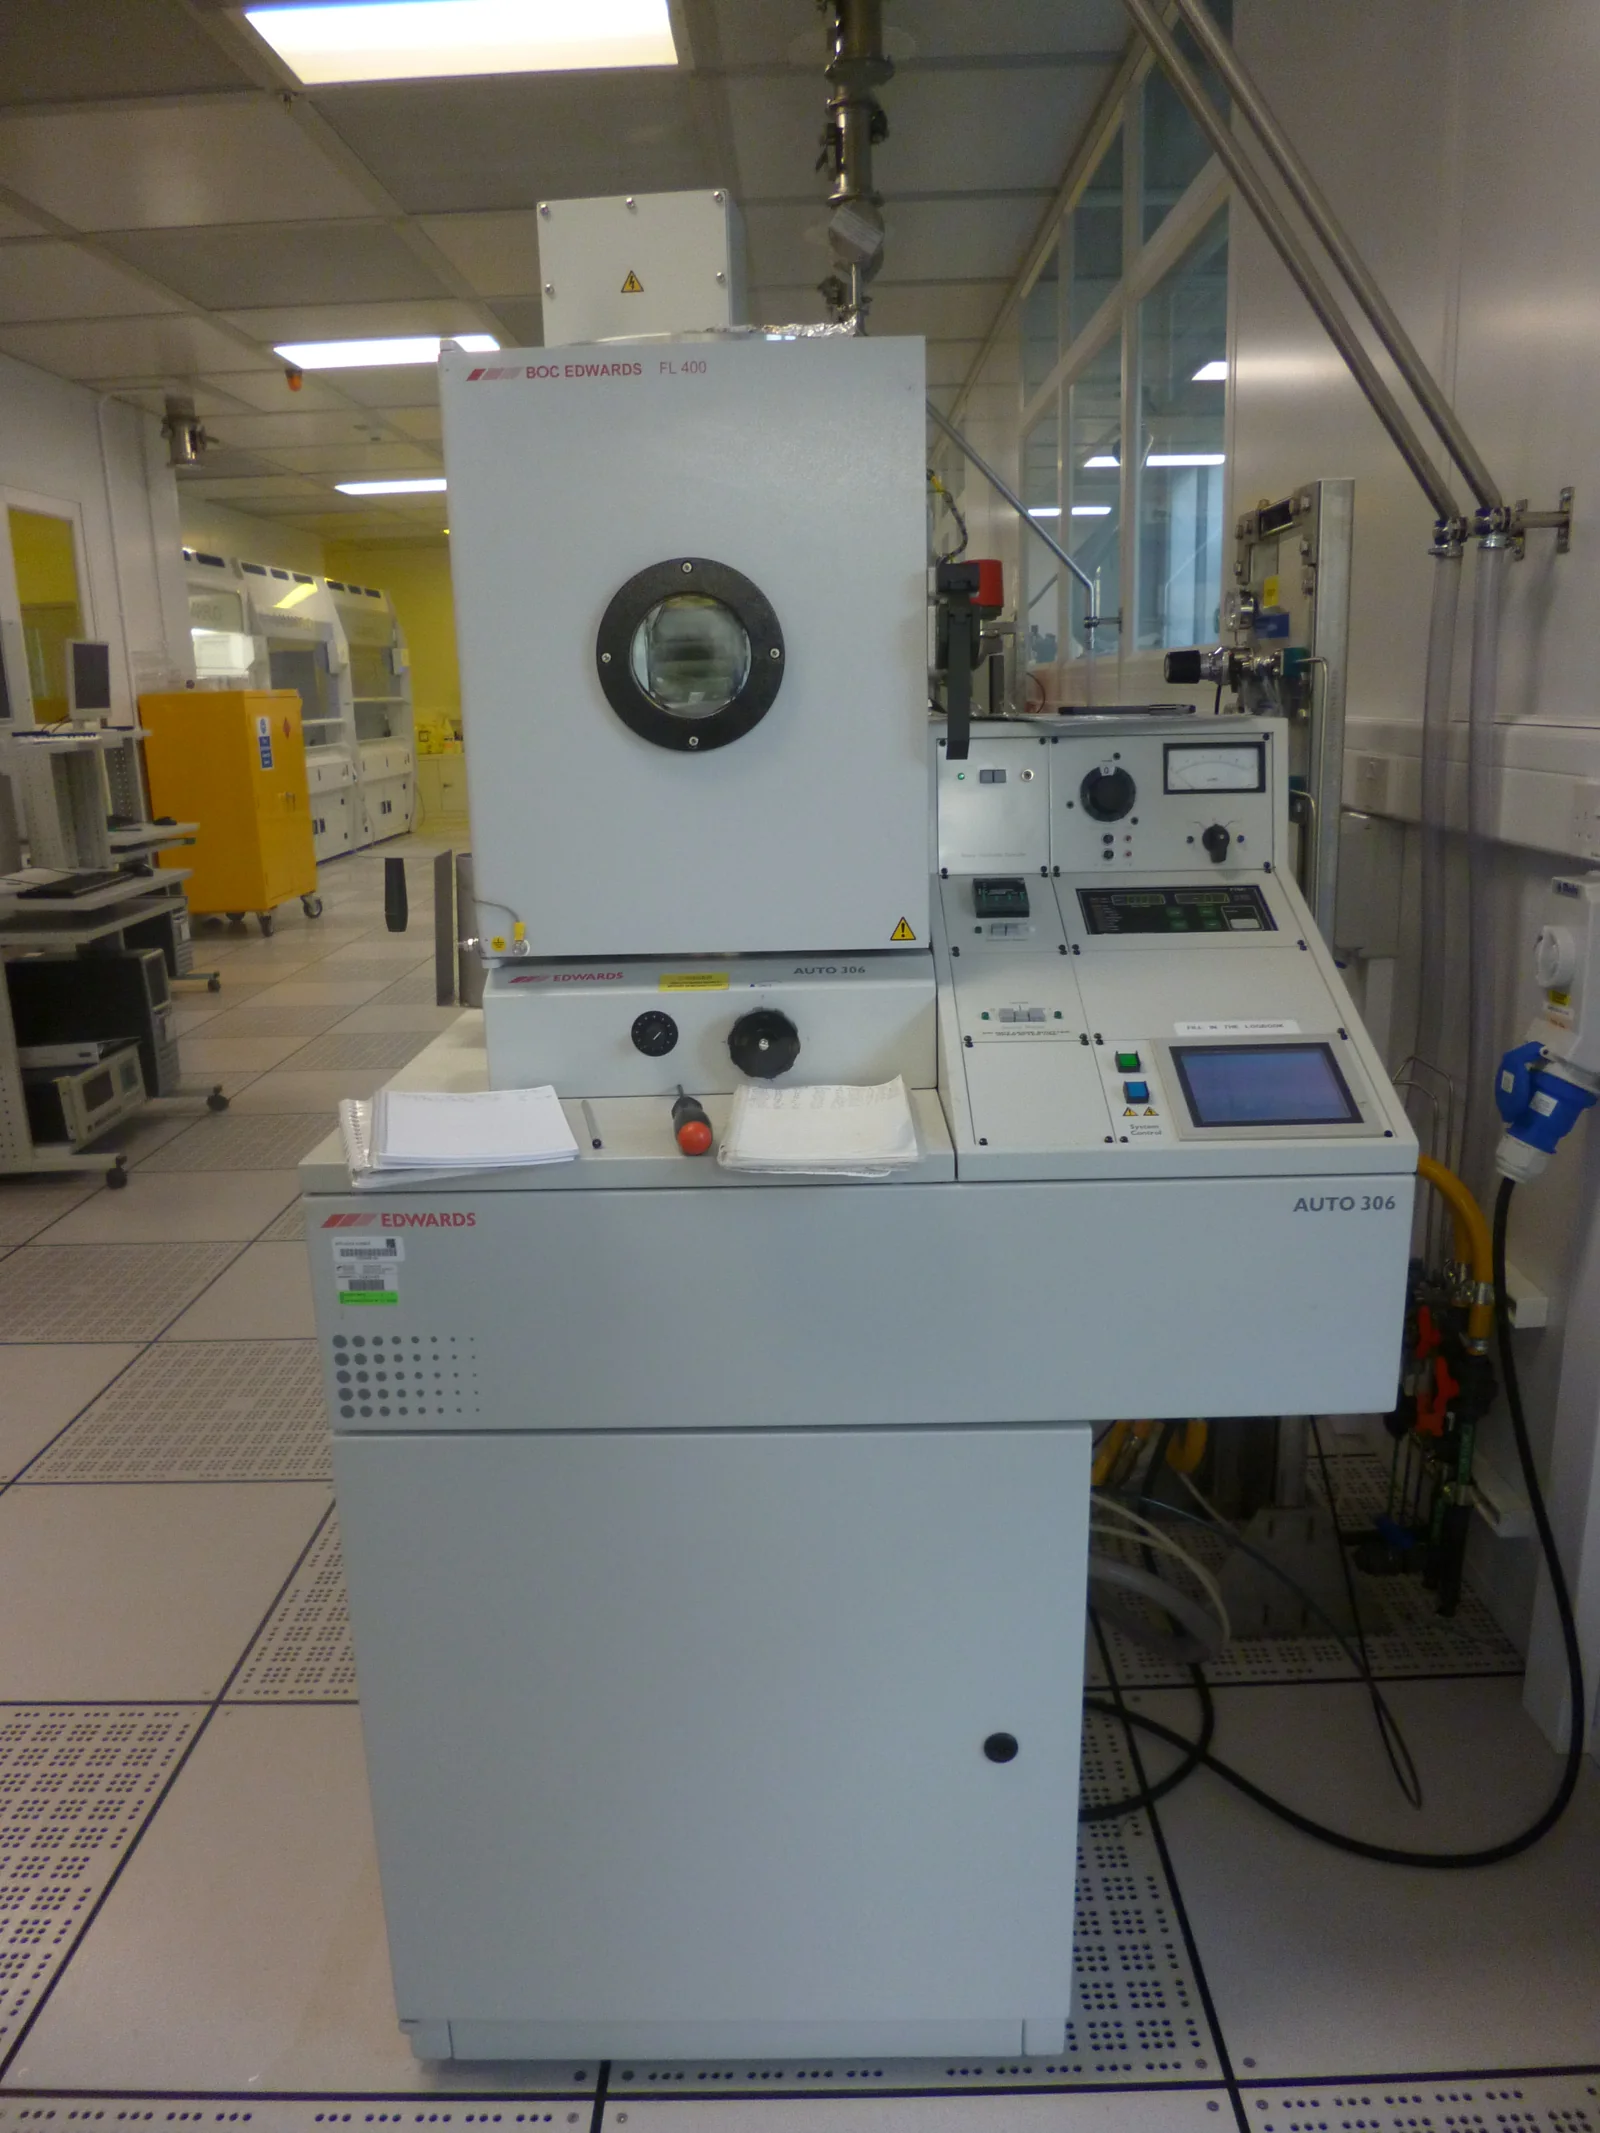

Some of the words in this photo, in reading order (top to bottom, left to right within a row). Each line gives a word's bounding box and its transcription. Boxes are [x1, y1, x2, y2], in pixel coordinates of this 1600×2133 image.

[526, 365, 559, 379] BOC
[564, 363, 642, 378] EDWARDS
[659, 362, 677, 375] FL
[681, 361, 706, 374] 400
[553, 972, 624, 982] EDWARDS
[793, 967, 837, 976] AUTO
[840, 965, 866, 974] 306
[1293, 1196, 1355, 1212] AUTO
[1361, 1195, 1396, 1210] 306
[381, 1212, 476, 1227] EDWARDS
